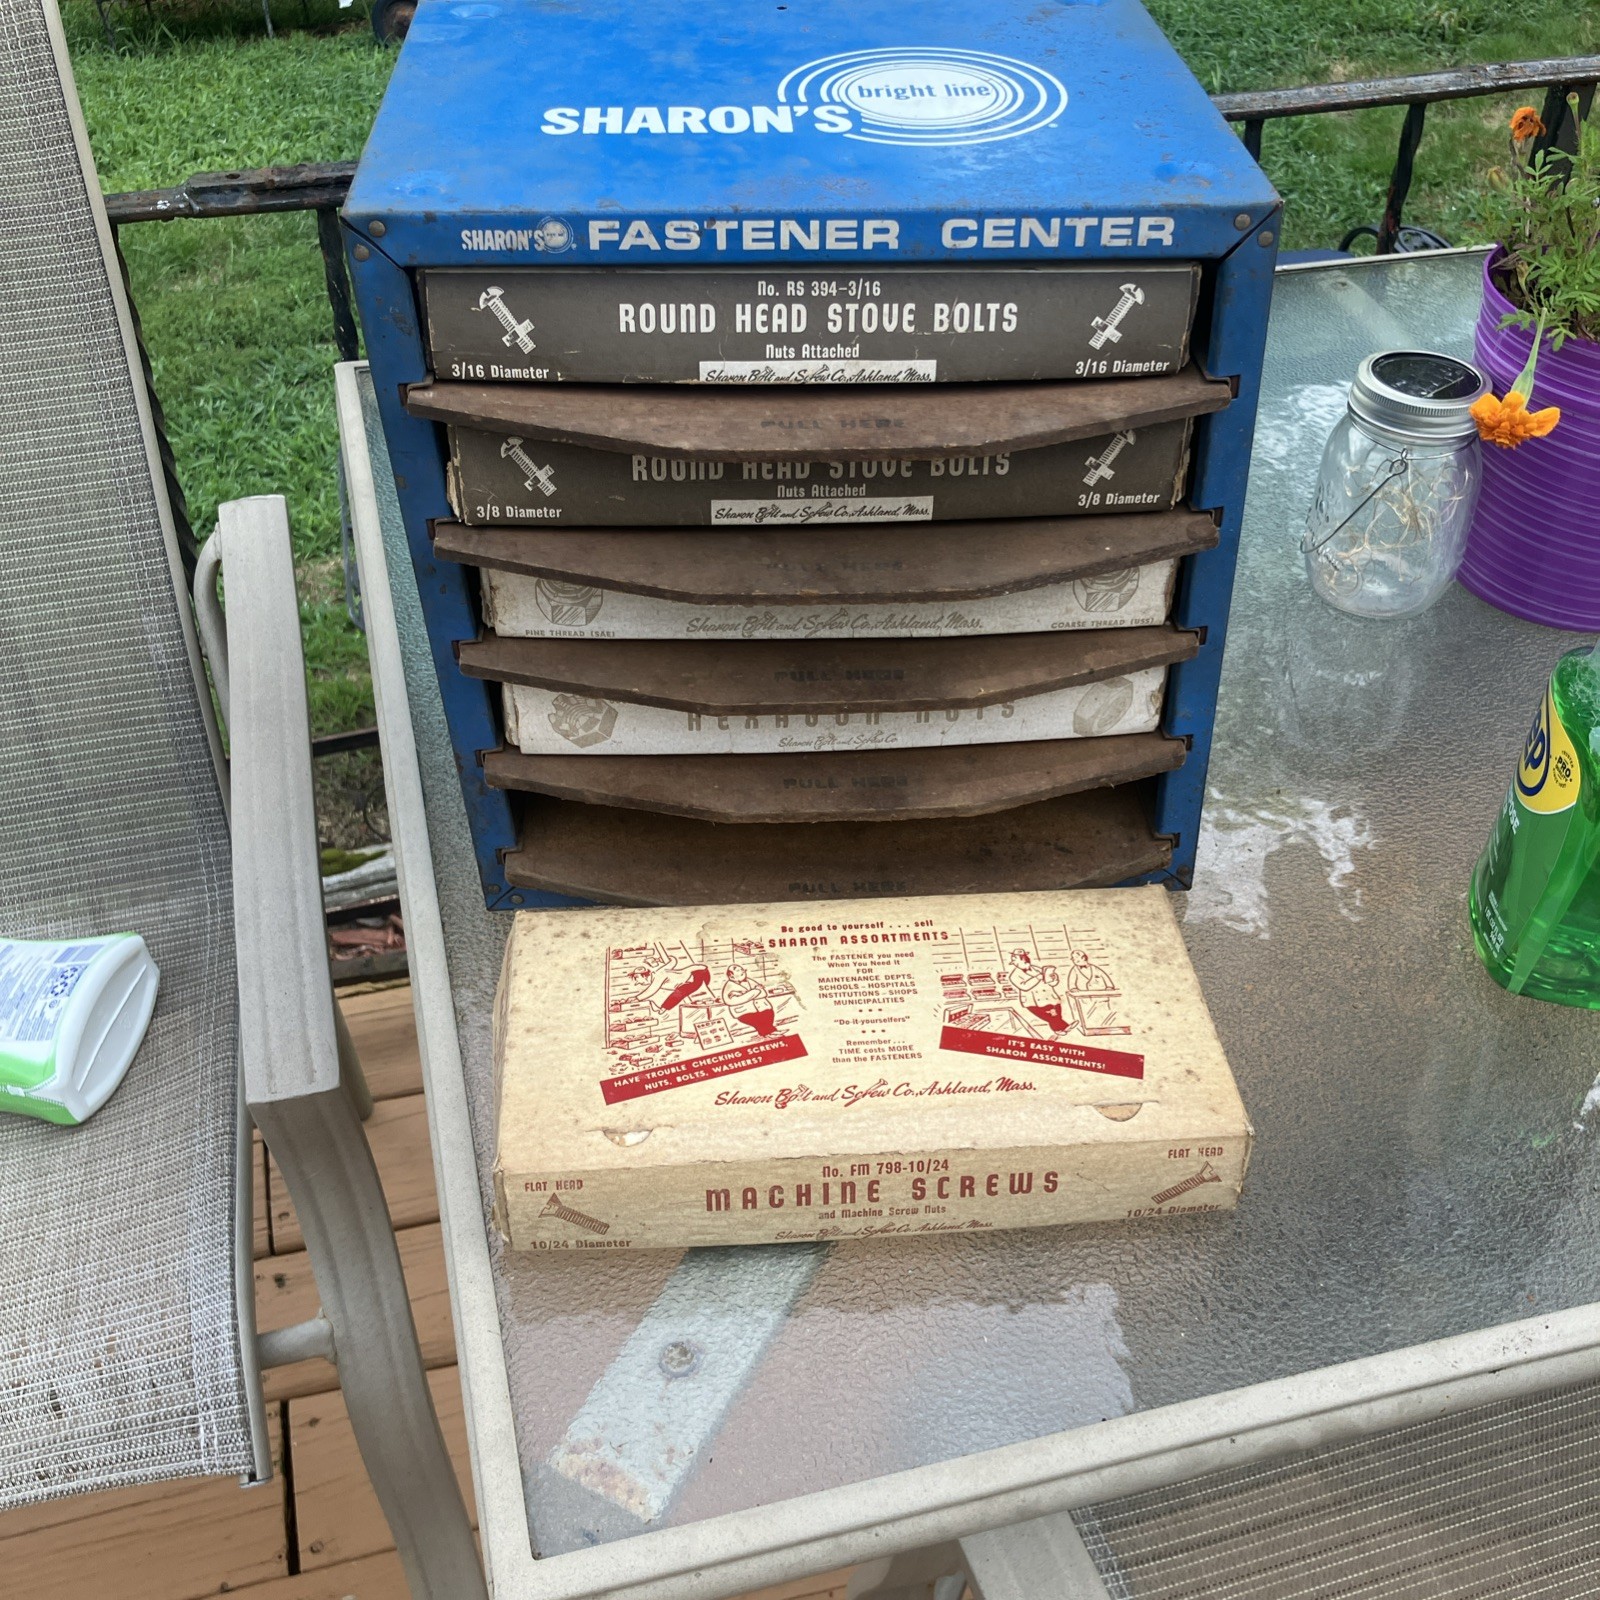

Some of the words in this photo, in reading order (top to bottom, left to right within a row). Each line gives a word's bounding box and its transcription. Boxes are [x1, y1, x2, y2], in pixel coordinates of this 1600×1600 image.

[858, 79, 938, 108] bright
[946, 76, 992, 99] line
[542, 104, 854, 137] SHARON'S
[460, 229, 545, 252] SHARON'S
[587, 218, 900, 252] FASTENER
[940, 215, 1175, 250] CENTER
[756, 280, 780, 298] No.
[786, 280, 805, 297] RS
[810, 278, 882, 300] 394-3/16
[618, 302, 718, 334] ROUND
[735, 302, 808, 334] HEAD
[826, 302, 917, 334] STOVE
[932, 301, 1019, 333] BOLTS
[765, 343, 796, 360] Nuts
[801, 342, 861, 359] Attached
[451, 361, 485, 380] 3/16
[490, 364, 550, 379] Diameter
[705, 369, 747, 383] Sharon
[748, 366, 775, 383] Bolt
[775, 371, 796, 382] and
[794, 364, 831, 384] Screw
[1074, 358, 1108, 377] 3/16
[1111, 360, 1171, 374] Diameter
[776, 484, 806, 498] Nuts
[811, 483, 866, 498] Attached
[1078, 491, 1101, 509] 3/8
[1105, 493, 1160, 505] Diameter
[476, 503, 500, 520] 3/8
[505, 505, 562, 519] Diameter
[714, 508, 754, 520] Sharon
[755, 504, 780, 524] Bolt
[781, 508, 801, 519] and
[801, 501, 835, 524] Screw
[524, 629, 546, 637] FINE
[549, 630, 585, 638] THREAD
[687, 616, 743, 633] Sharon
[778, 618, 803, 631] and
[1050, 620, 1087, 630] COARSE
[1091, 619, 1126, 628] THREAD
[777, 736, 814, 748] Sharon
[1557, 755, 1571, 778] PRO
[780, 925, 795, 935] Be
[799, 923, 824, 935] good
[827, 923, 838, 933] to
[842, 921, 885, 934] yourself
[914, 919, 934, 929] sell
[768, 936, 828, 949] SHARON
[839, 931, 950, 946] ASSORTMENTS
[830, 953, 874, 961] FASTENER
[894, 951, 915, 959] need
[817, 975, 881, 984] MAINTENANCE
[884, 973, 916, 981] DEPTS.
[818, 983, 860, 992] SCHOOLS
[867, 981, 917, 989] HOSPITALS
[818, 990, 880, 999] INSTITUTIONS
[888, 988, 918, 996] SHOPS
[833, 997, 906, 1007] MUNICIPALITIES
[1007, 1039, 1026, 1049] IT'S
[1029, 1042, 1056, 1053] EASY
[1057, 1046, 1087, 1058] WITH
[711, 1056, 764, 1074] WASHERS?
[832, 1056, 852, 1064] than
[870, 1052, 923, 1062] FASTENERS
[985, 1046, 1029, 1059] SHARON
[1031, 1053, 1107, 1071] ASSORTMENTS!
[613, 1074, 642, 1088] HAVE
[645, 1064, 688, 1080] TROUBLE
[691, 1051, 743, 1069] CHECKING
[714, 1090, 774, 1107] Sharon
[774, 1084, 815, 1111] Bolt
[812, 1088, 844, 1103] and
[840, 1078, 894, 1109] Screw
[995, 1076, 1038, 1094] Mass.
[1167, 1148, 1191, 1159] FLAT
[1197, 1146, 1224, 1157] HEAD
[821, 1163, 845, 1179] No.
[849, 1162, 872, 1177] FM
[875, 1158, 951, 1176] 798-10/24
[524, 1181, 548, 1192] FLAT
[555, 1179, 584, 1191] HEAD
[705, 1178, 882, 1214] MACHINE
[911, 1169, 1062, 1202] SCREWS
[818, 1209, 836, 1220] and
[841, 1205, 884, 1218] Machine
[888, 1204, 920, 1216] Screw
[923, 1204, 947, 1215] Nuts
[1127, 1206, 1163, 1219] 10/24
[1168, 1203, 1222, 1215] Diameter
[530, 1240, 570, 1250] 10/24
[575, 1239, 632, 1249] Diameter
[774, 1230, 816, 1241] Sharon
